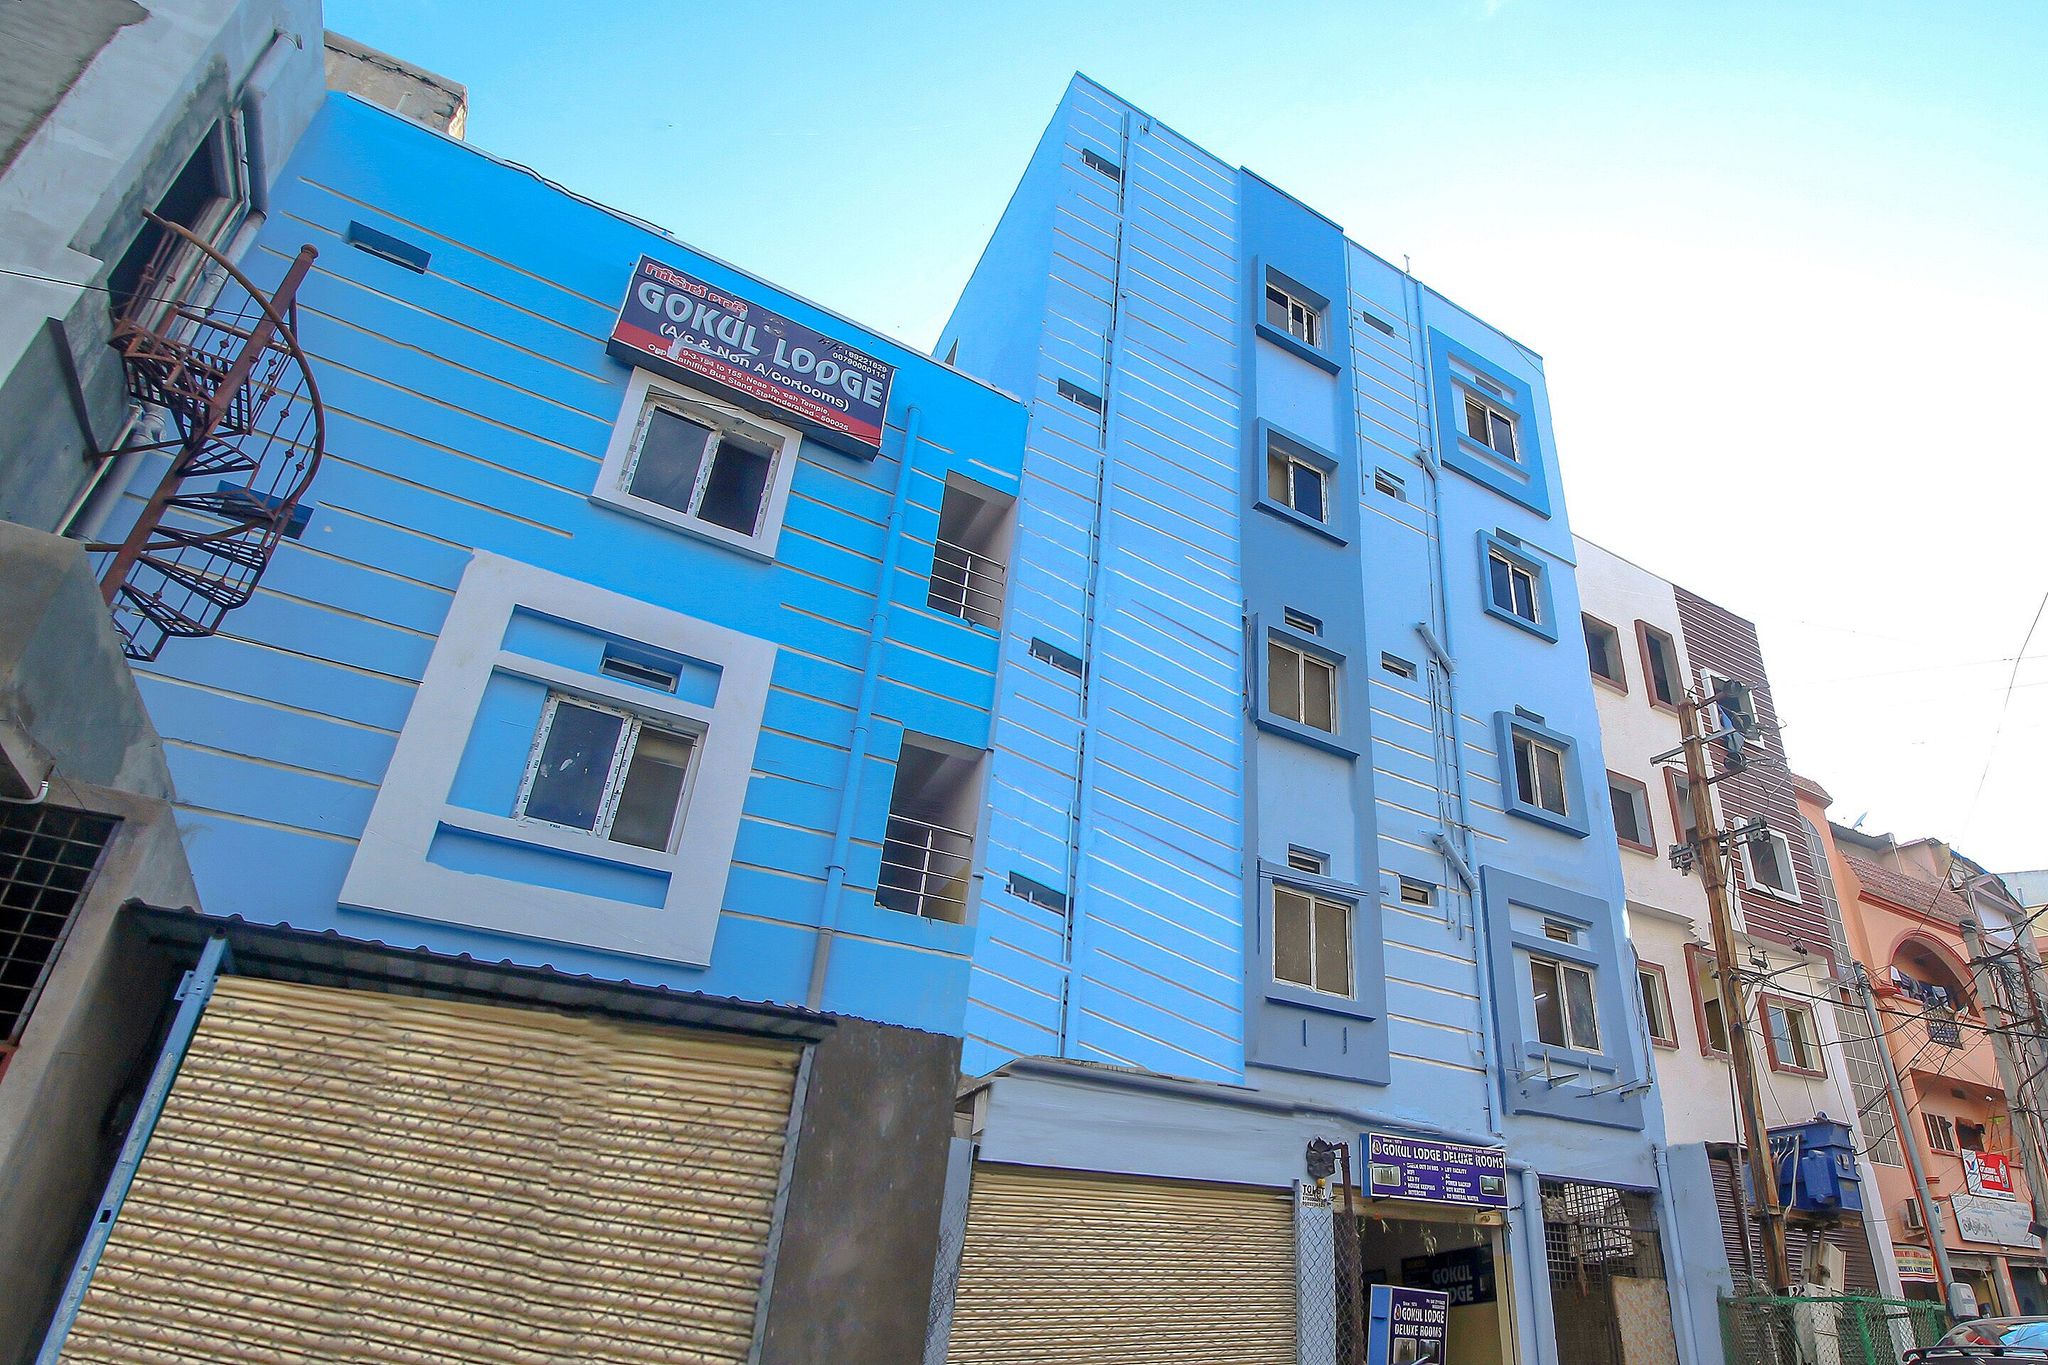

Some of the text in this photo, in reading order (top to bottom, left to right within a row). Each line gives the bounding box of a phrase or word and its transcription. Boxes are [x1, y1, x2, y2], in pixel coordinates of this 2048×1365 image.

[637, 280, 884, 408] GOKUL LODGE
[716, 345, 750, 368] Non
[709, 365, 727, 381] Bus
[1382, 1143, 1412, 1158] GOKUL
[1413, 1146, 1441, 1161] LODGE
[1443, 1150, 1473, 1166] DELUXE
[1475, 1154, 1503, 1169] ROOMS
[1432, 1265, 1473, 1285] GOKUL
[1402, 1307, 1445, 1324] GOKUL LODGE
[1394, 1323, 1443, 1338] DELUXE ROOMS
